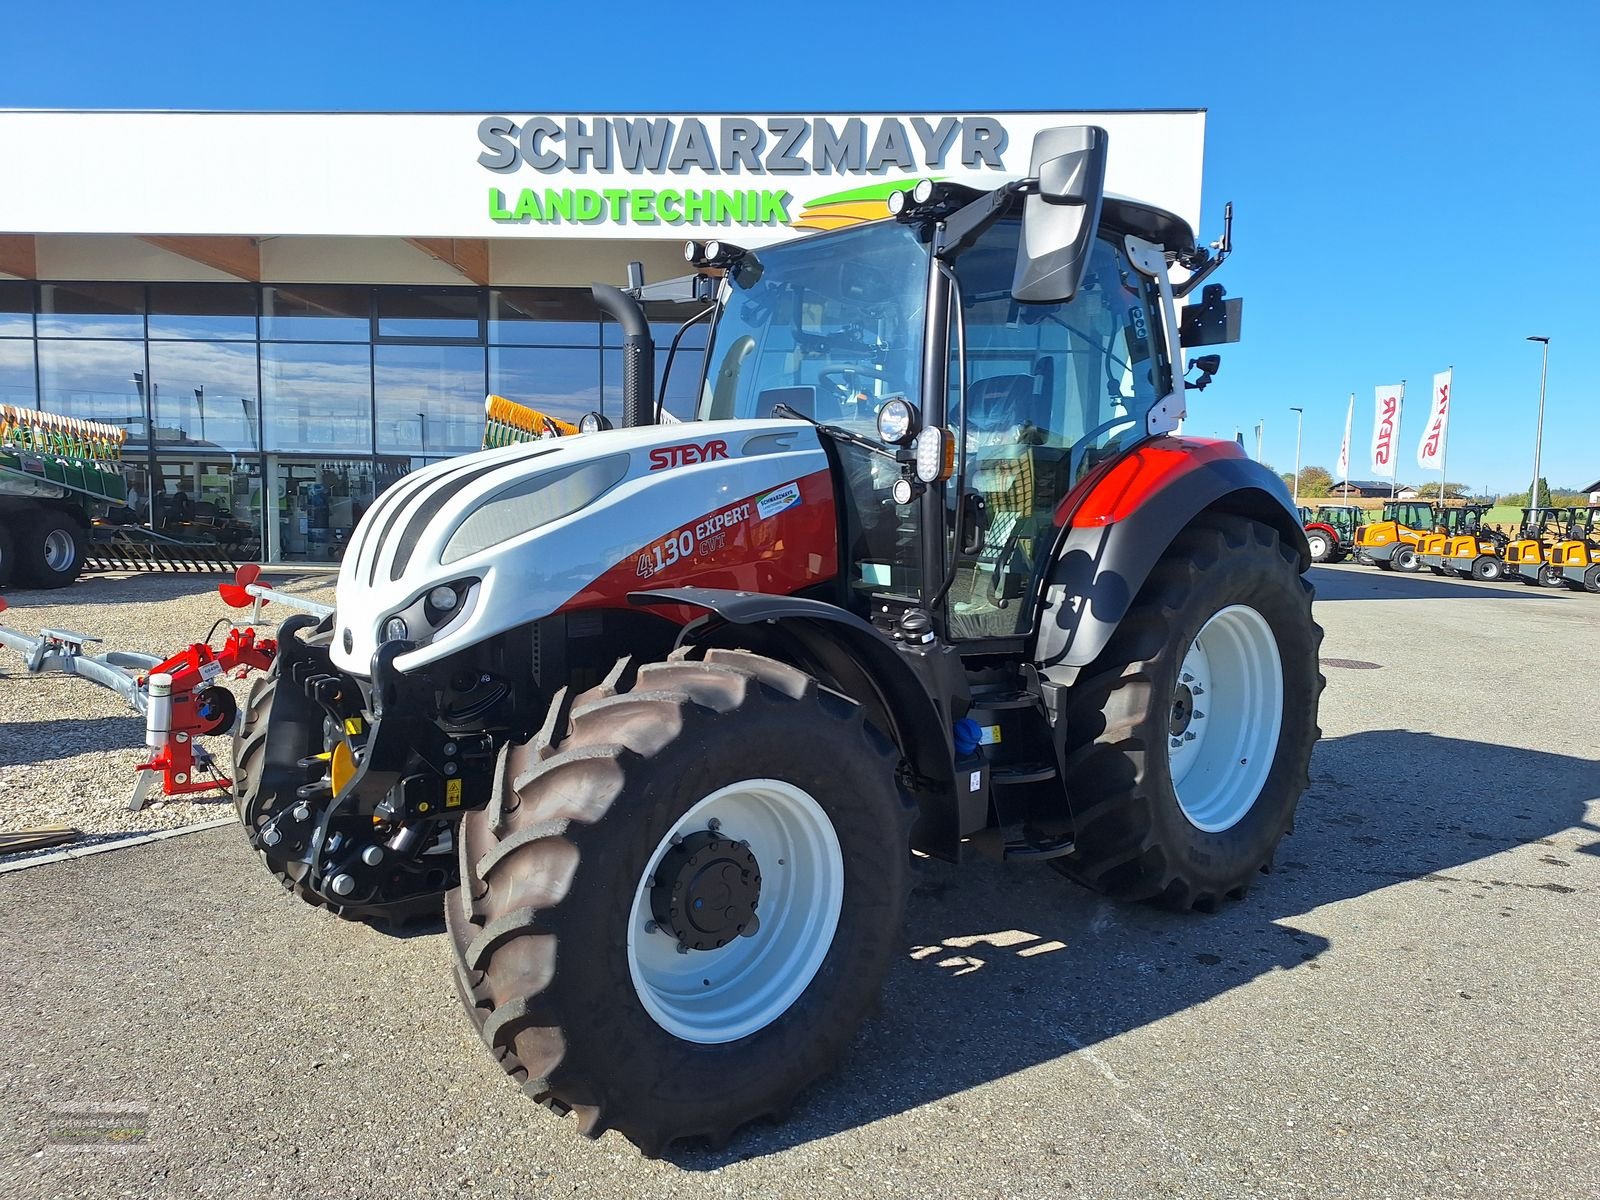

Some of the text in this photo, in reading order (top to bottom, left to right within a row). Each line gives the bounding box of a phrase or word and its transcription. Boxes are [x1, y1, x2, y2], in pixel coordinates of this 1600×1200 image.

[477, 116, 1005, 173] SCHWARZMAYR
[489, 187, 790, 225] LANDTECHNIK
[649, 439, 729, 471] STEYR
[636, 503, 750, 579] 4130 EXPERT
[699, 532, 726, 556] CVT
